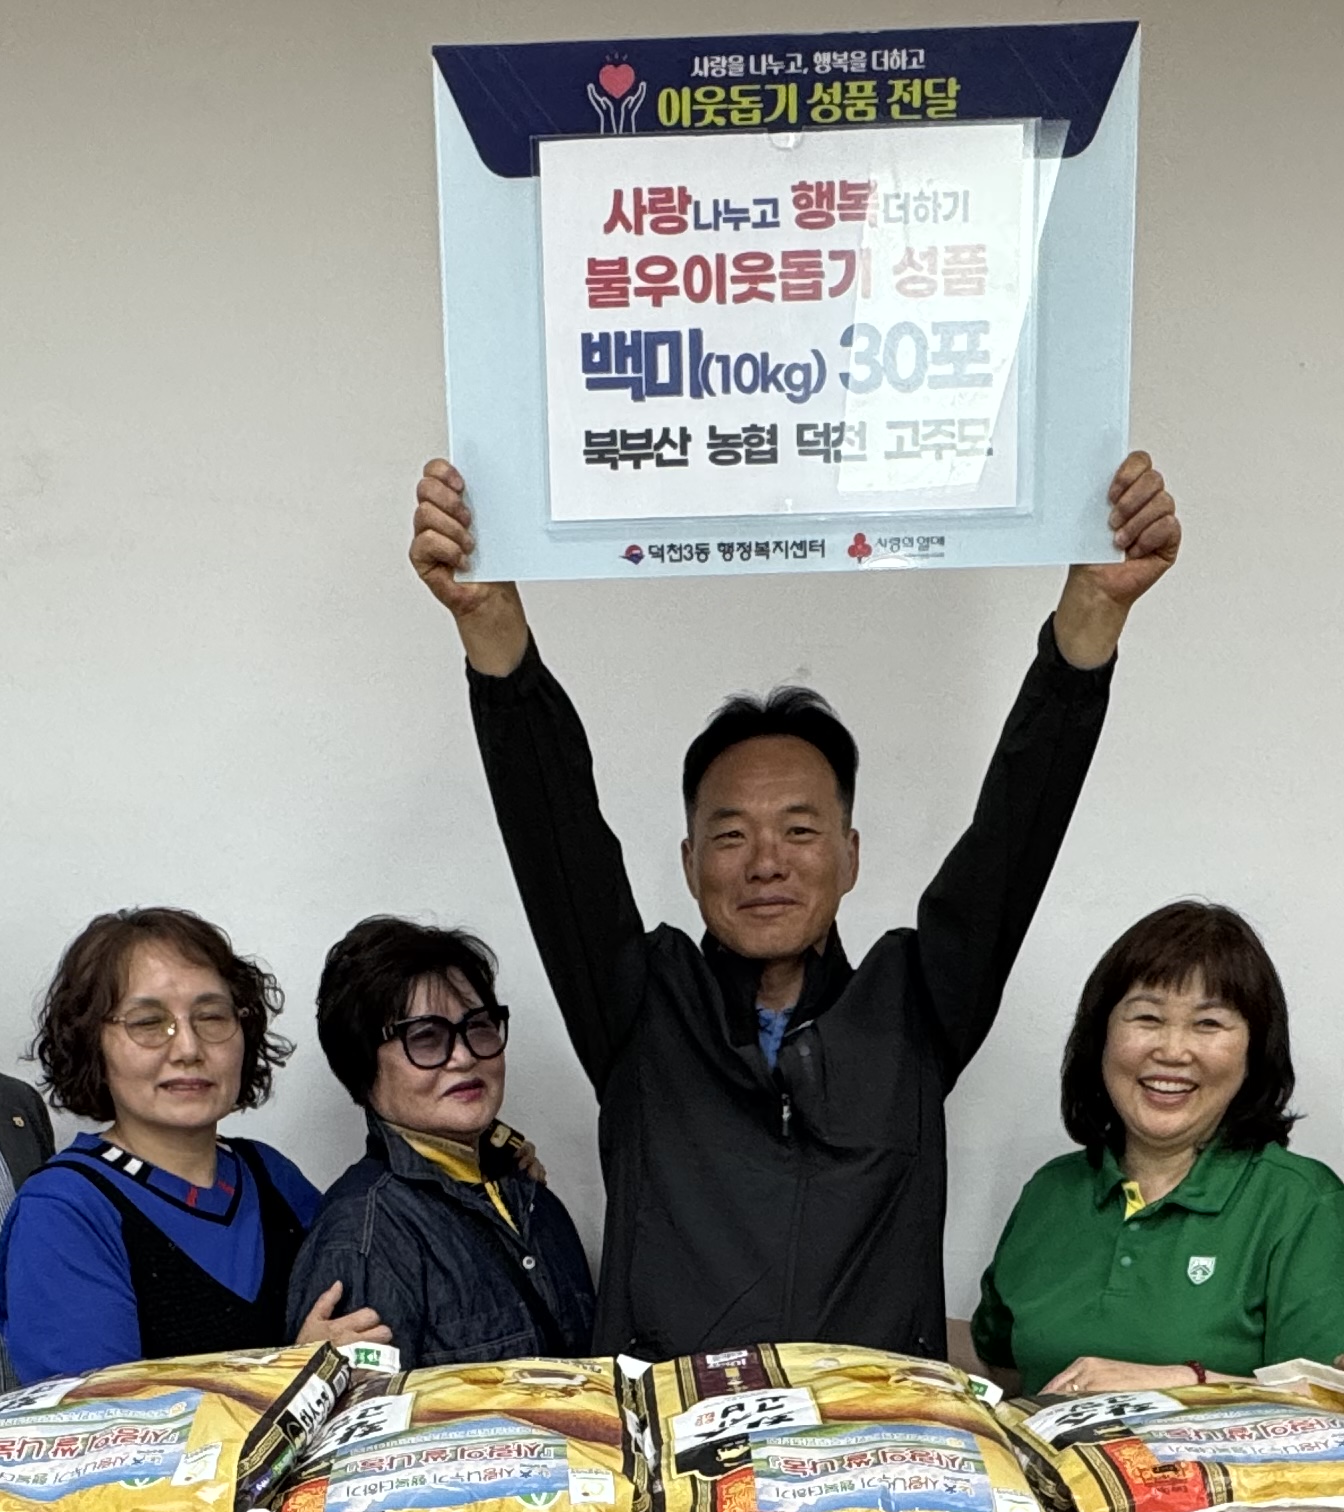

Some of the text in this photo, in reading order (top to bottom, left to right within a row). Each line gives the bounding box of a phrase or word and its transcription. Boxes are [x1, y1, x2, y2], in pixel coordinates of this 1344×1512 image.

[690, 48, 926, 78] 사랑을 나누고, 행복을 더하고
[657, 76, 961, 128] 이웃돕기 성품 전달
[584, 243, 988, 308] 불우이웃돕기 성품
[580, 320, 994, 405] 백미(10kg) 30포
[582, 424, 692, 470] 북부산
[707, 423, 779, 466] 농협
[796, 420, 868, 464] 덕천
[648, 538, 826, 564] 덕천3동 행정복지센터
[345, 1474, 428, 1499] 행복더하기
[432, 1466, 516, 1486] 사랑나누기
